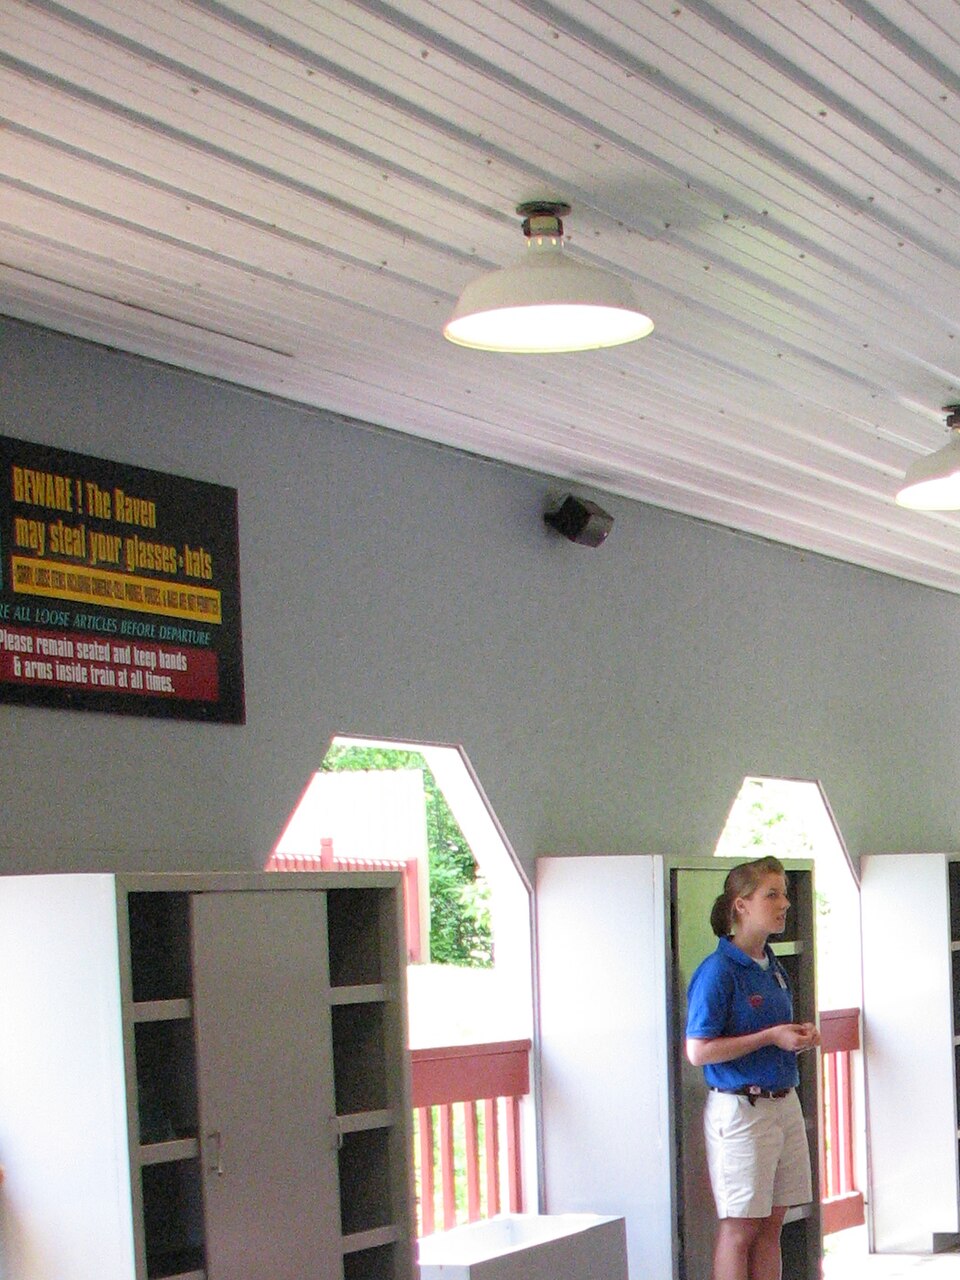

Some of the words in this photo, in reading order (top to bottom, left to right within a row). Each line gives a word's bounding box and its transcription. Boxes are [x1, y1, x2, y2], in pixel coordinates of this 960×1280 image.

[13, 466, 73, 513] BEWARE
[86, 481, 112, 520] The
[114, 487, 157, 529] Raven
[15, 518, 45, 557] may
[49, 518, 86, 558] steal
[90, 531, 122, 566] your
[126, 534, 177, 574] glasses
[184, 544, 213, 580] hats
[13, 605, 31, 622] ALL
[35, 608, 71, 627] LOOSE
[73, 613, 117, 633] ARTICLES
[120, 620, 155, 638] BEFORE
[159, 625, 211, 645] DEPARTURE
[36, 636, 74, 659] remain
[76, 640, 110, 663] seated
[113, 645, 131, 665] and
[133, 646, 157, 671] keep
[159, 649, 188, 672] hands
[13, 656, 22, 678] &
[25, 660, 53, 681] arms
[55, 660, 88, 684] inside
[90, 664, 116, 687] train
[118, 668, 128, 688] at
[130, 669, 143, 690] all
[145, 670, 176, 693] times.
